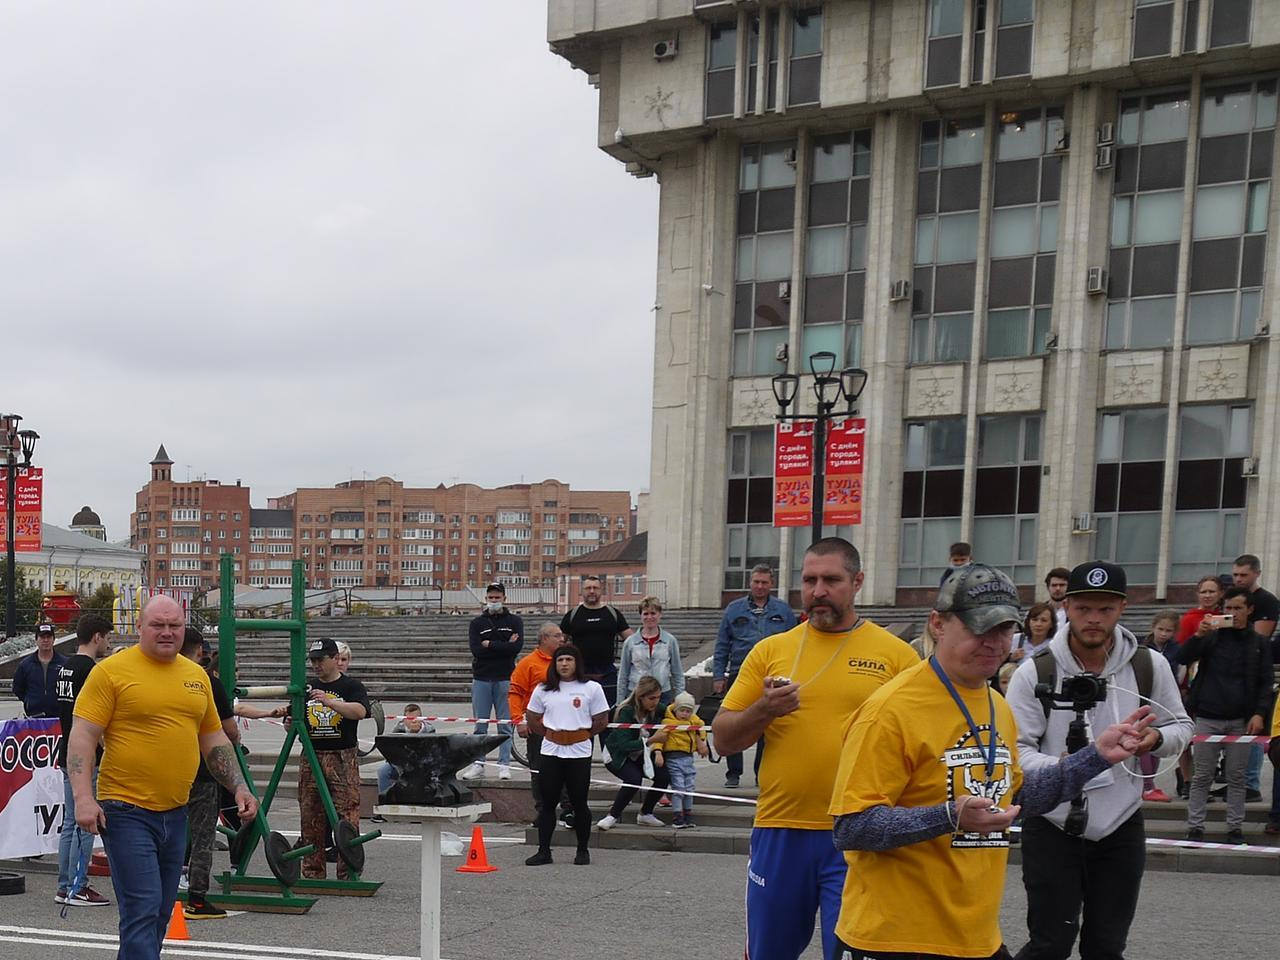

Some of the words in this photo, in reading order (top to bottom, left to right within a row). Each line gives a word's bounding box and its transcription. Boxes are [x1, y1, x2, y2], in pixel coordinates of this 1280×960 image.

[776, 481, 810, 491] ТУЛА
[827, 479, 861, 489] ТУЛА
[848, 660, 887, 672] СИЛА
